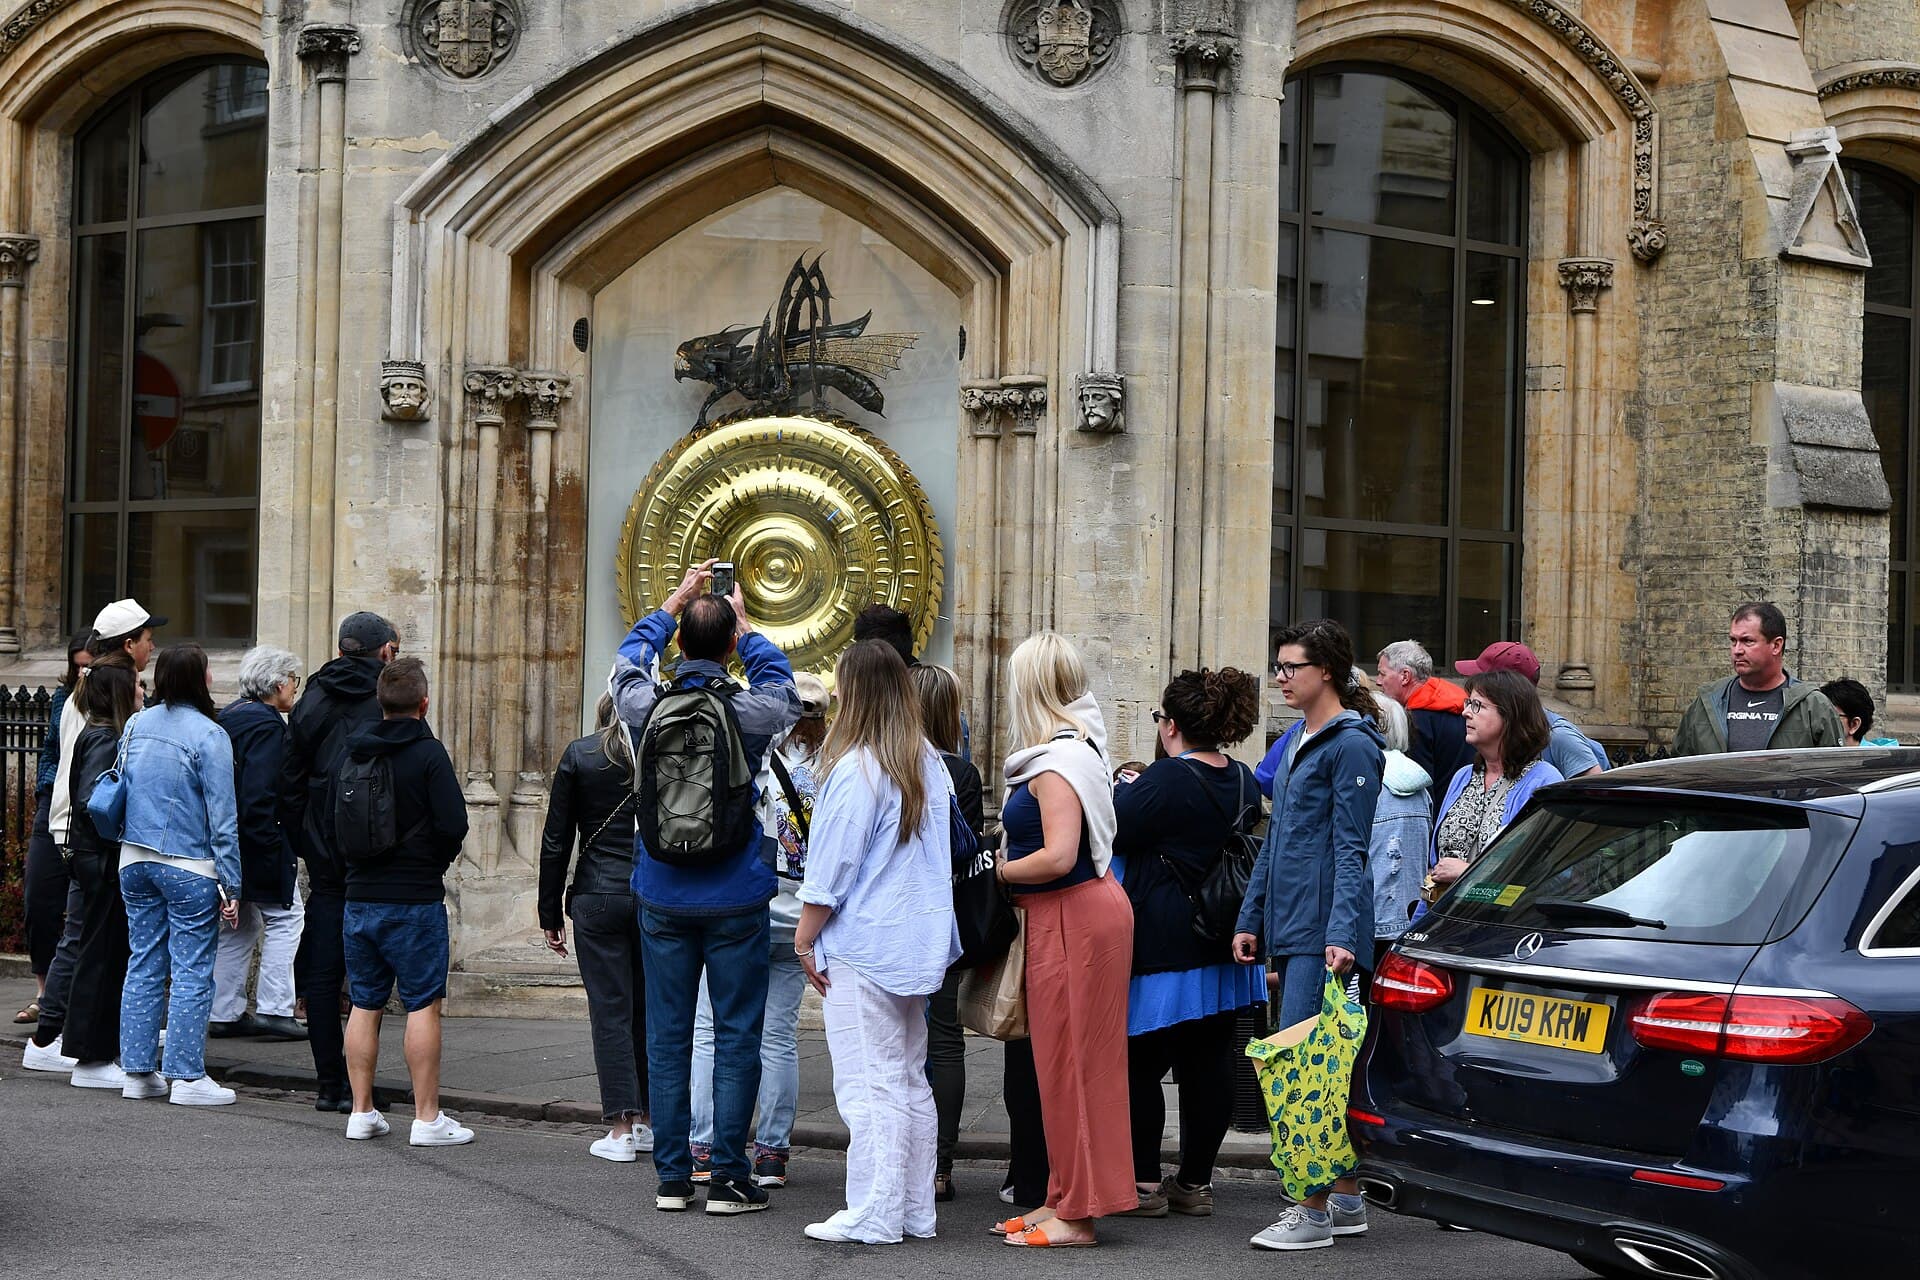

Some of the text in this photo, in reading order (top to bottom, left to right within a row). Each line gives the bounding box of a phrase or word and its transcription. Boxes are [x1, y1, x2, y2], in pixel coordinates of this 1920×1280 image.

[1727, 712, 1761, 720] RGINIA
[1479, 993, 1592, 1043] KU19 KRW
